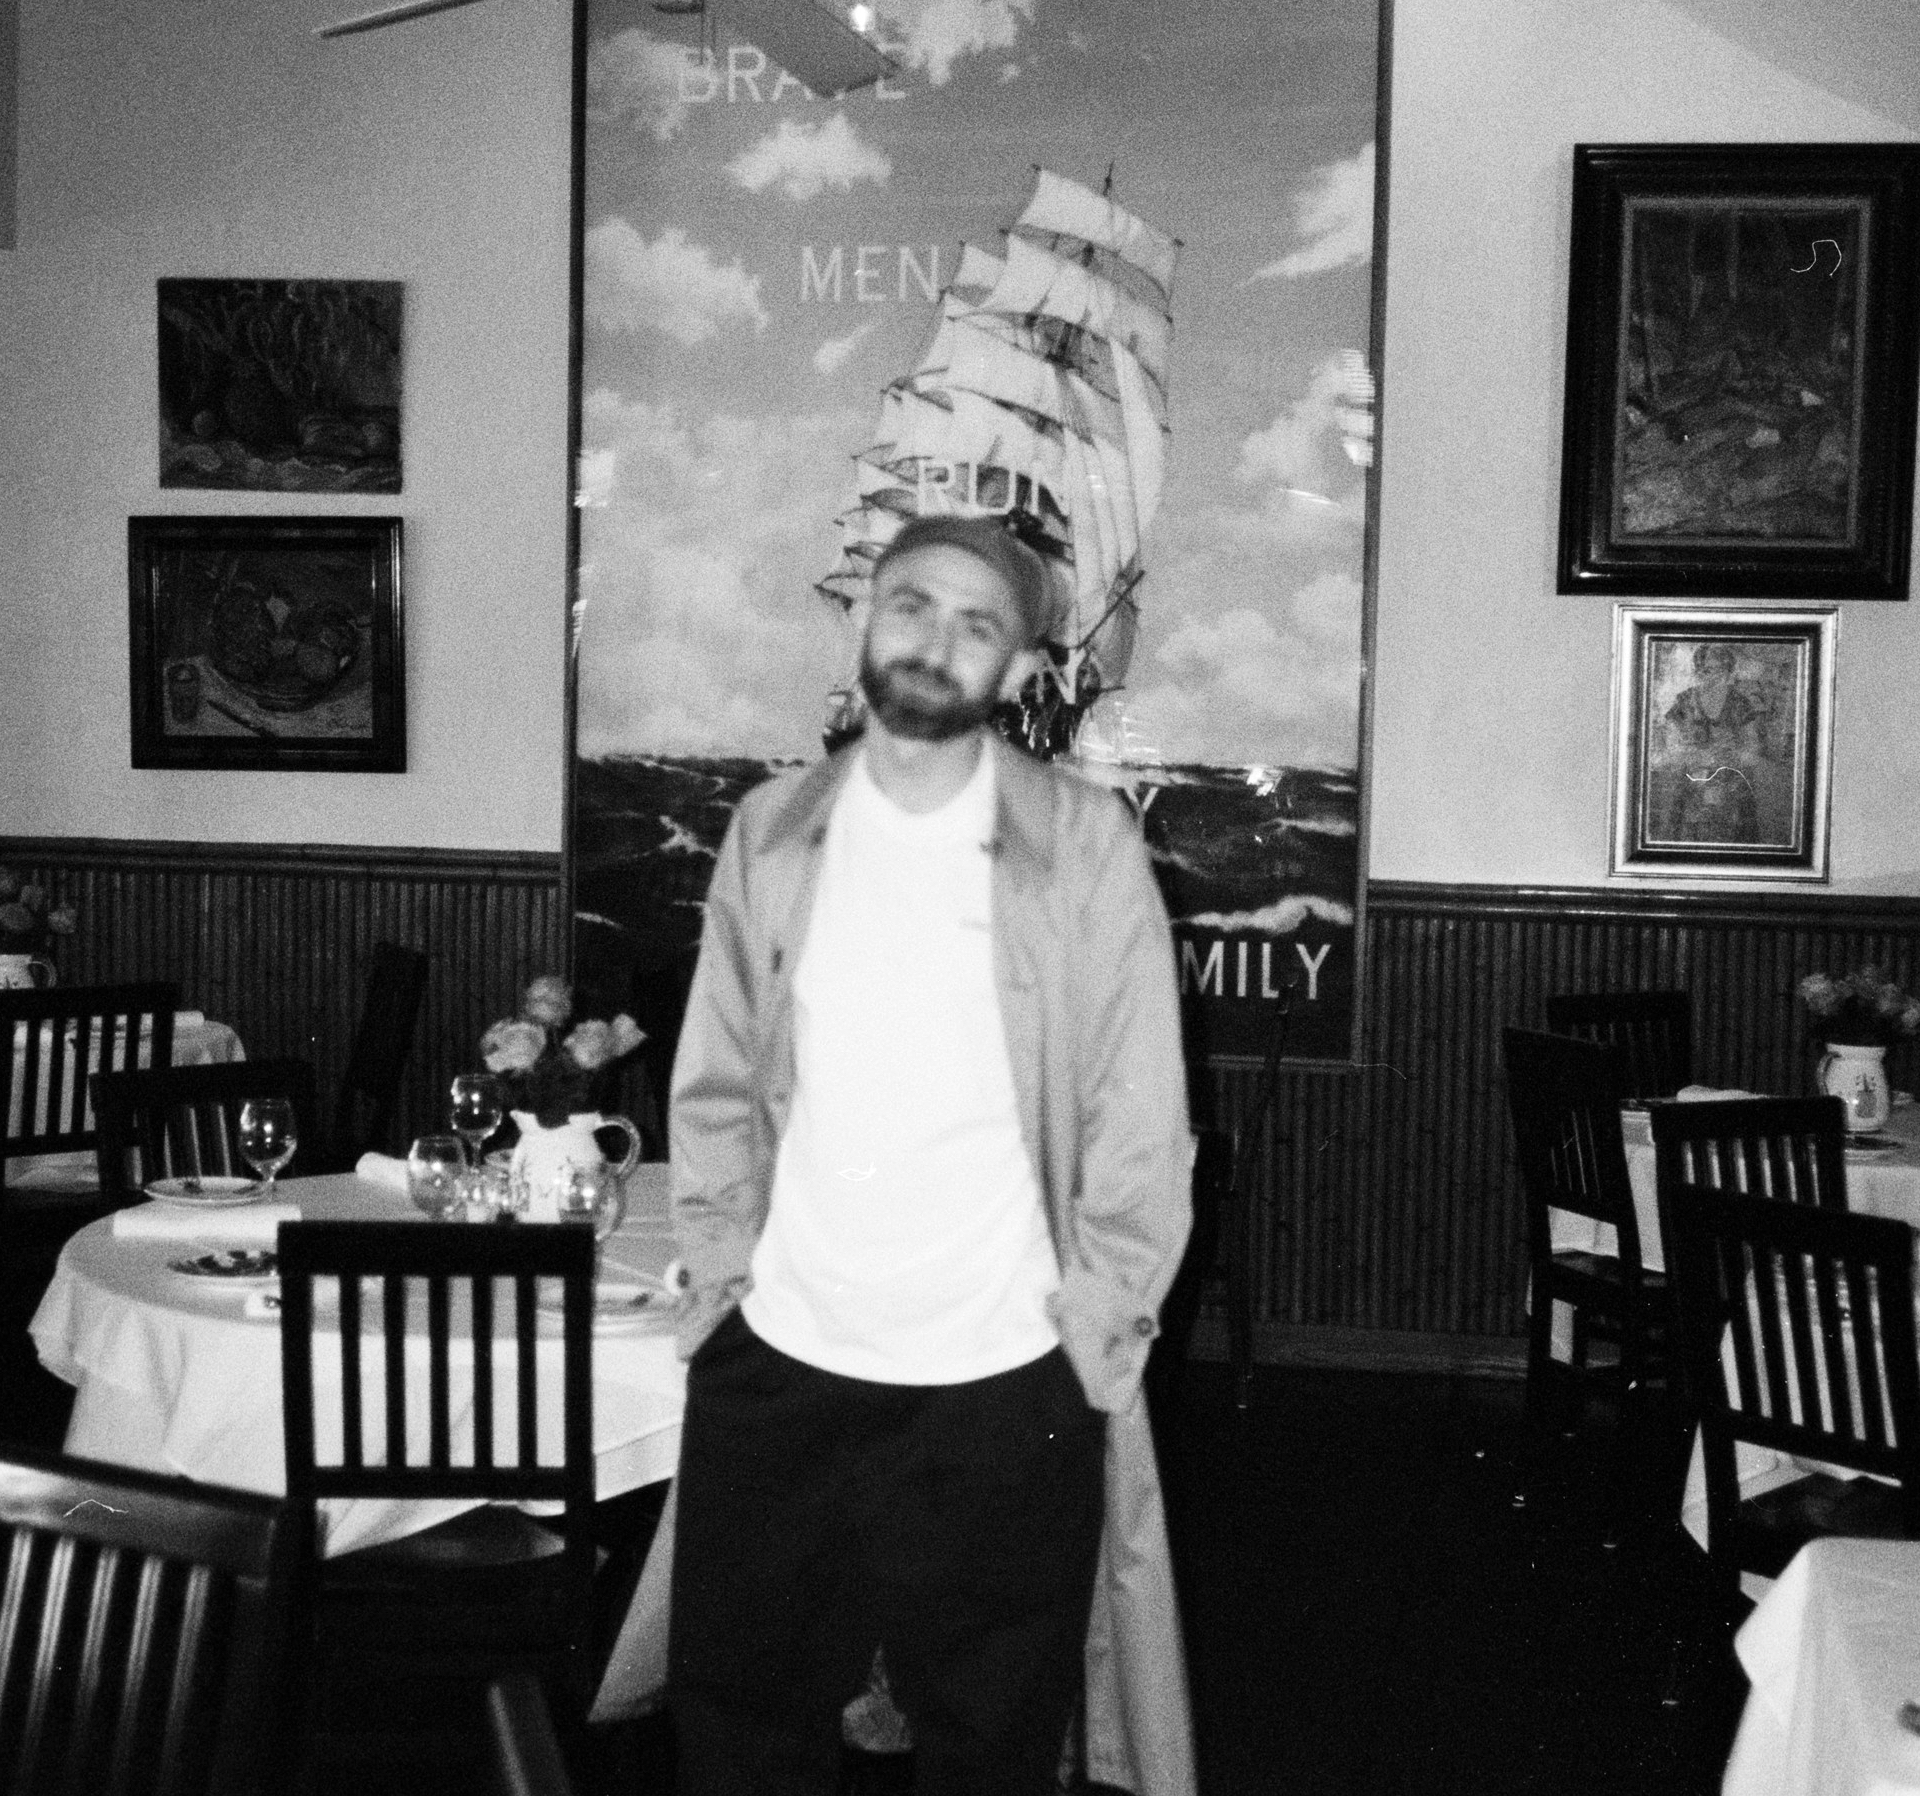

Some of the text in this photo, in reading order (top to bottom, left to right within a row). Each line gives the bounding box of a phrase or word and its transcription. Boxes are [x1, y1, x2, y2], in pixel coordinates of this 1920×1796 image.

[679, 44, 906, 101] BRAE
[802, 246, 938, 301] MEN
[1180, 939, 1332, 1001] MILY
